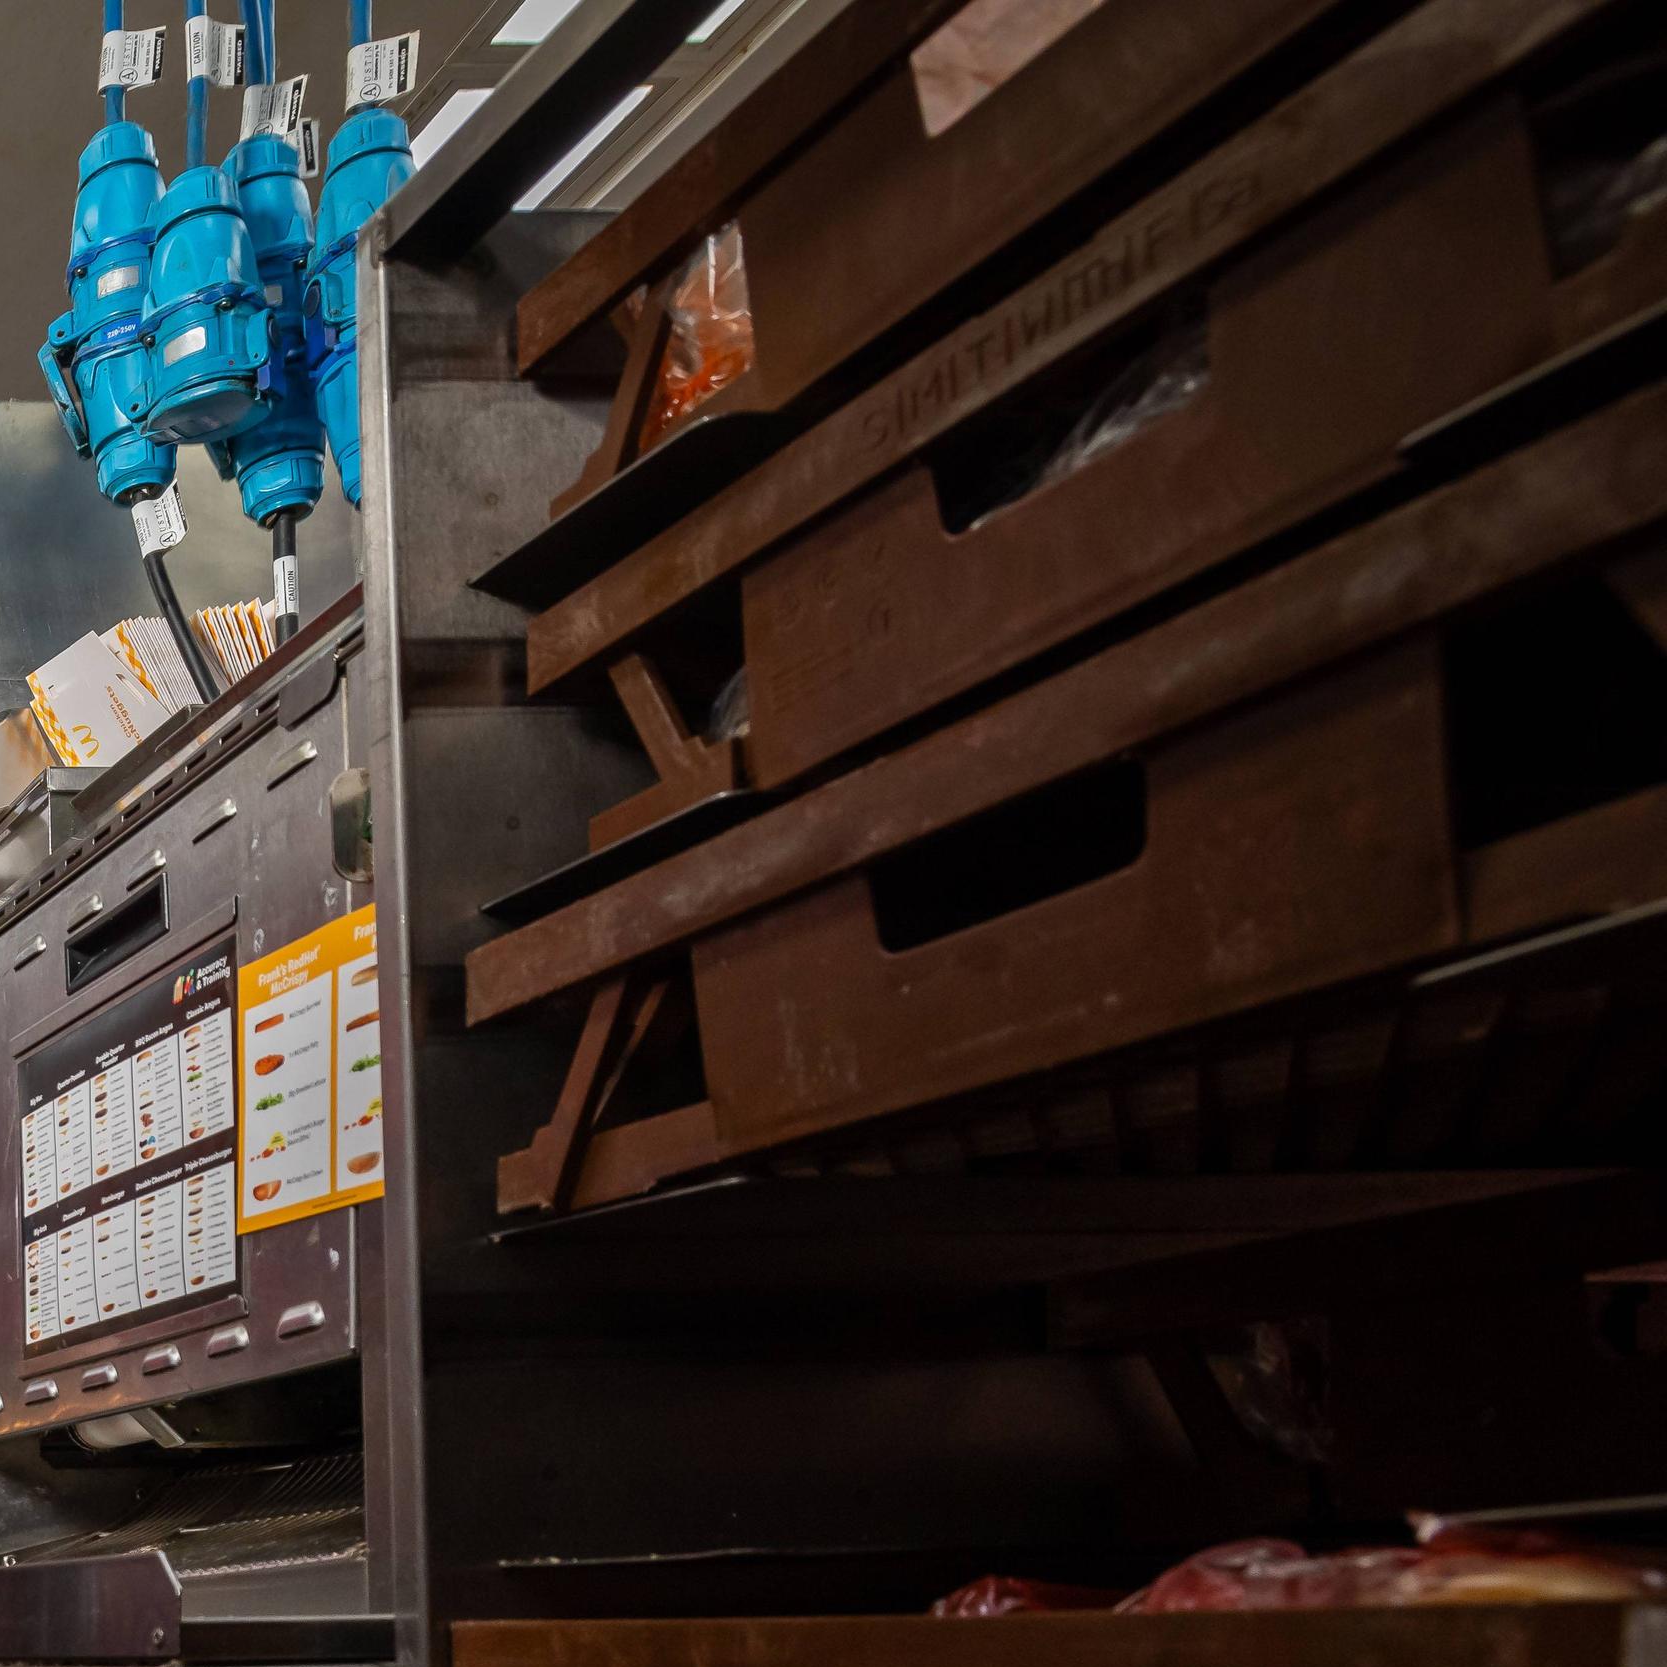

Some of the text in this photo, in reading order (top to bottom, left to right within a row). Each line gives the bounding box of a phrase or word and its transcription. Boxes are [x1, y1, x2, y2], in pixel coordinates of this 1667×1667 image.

[194, 31, 202, 65] CAUTION
[107, 324, 136, 339] 220-250V
[110, 704, 132, 738] Chicken
[353, 923, 378, 942] Fran
[196, 965, 231, 991] & Training
[197, 956, 228, 978] Accuracy
[258, 963, 287, 988] Frank's
[270, 970, 309, 995] McCrispy
[186, 997, 221, 1020] Classic Angus
[184, 1147, 233, 1172] Triple Cheeseburger
